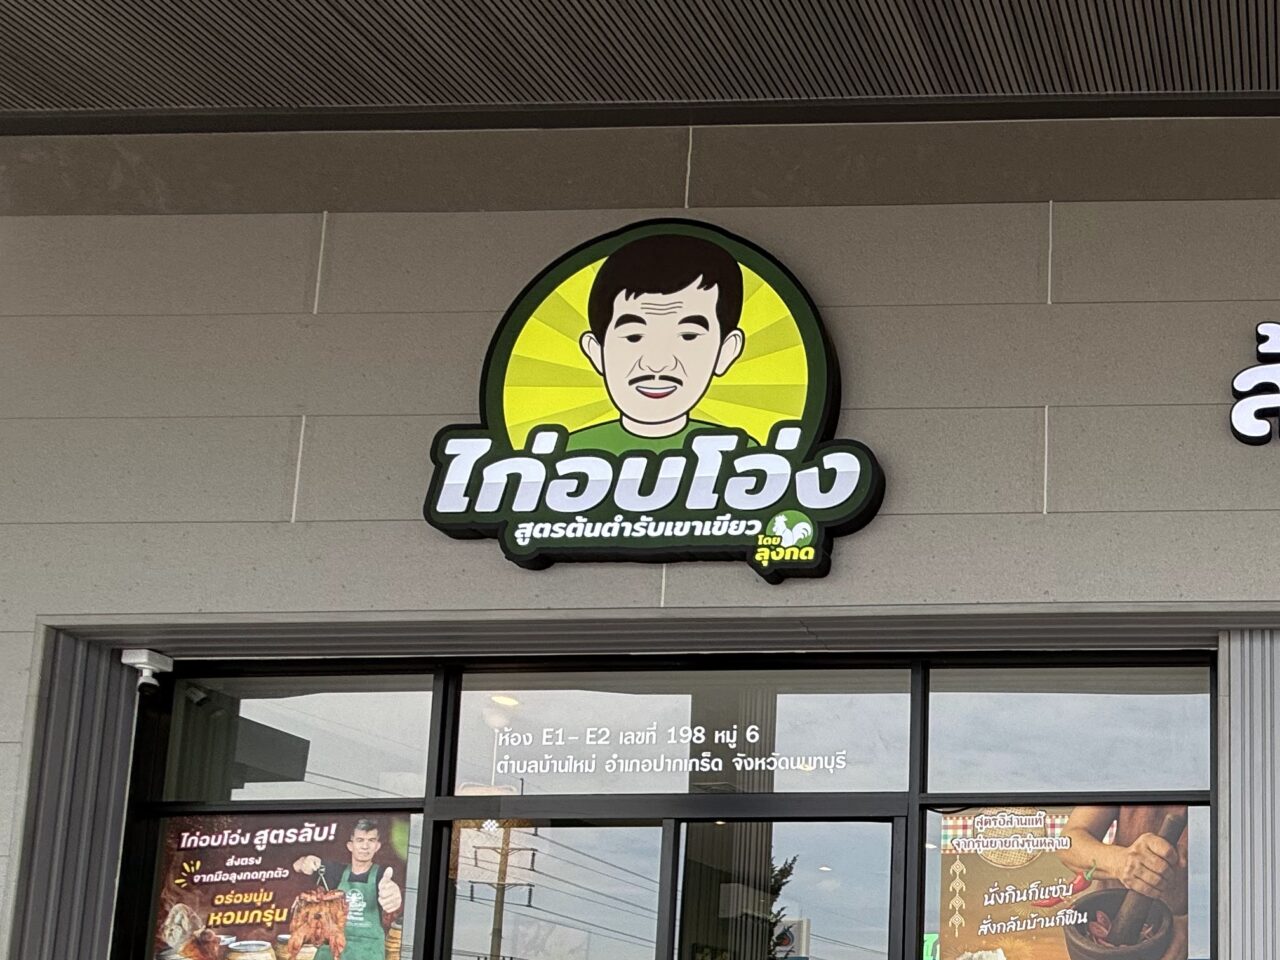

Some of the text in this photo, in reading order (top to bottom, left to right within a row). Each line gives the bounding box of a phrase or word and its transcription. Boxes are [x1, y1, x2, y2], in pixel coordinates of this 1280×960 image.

[435, 427, 862, 514] ไก่อบโอ่ง
[513, 508, 762, 547] สูตรต้นตำรับเขาเขียว
[757, 534, 781, 546] โดย
[754, 543, 815, 567] ลุงกด
[497, 728, 533, 746] ห้อง
[585, 728, 611, 745] E2
[618, 722, 657, 746] เลขที่
[666, 725, 706, 744] 198
[714, 725, 738, 749] หมู่
[745, 725, 760, 744] 6
[496, 749, 848, 775] ตำบลบ้านใหม่ อำเภอปากเกร็ด จังหวัดนนทบุรี
[179, 822, 338, 851] ไก่อบโอ่ง สูตรลับ!
[225, 855, 263, 868] ส่งตรง
[213, 888, 274, 907] อร่อยนุ่ม
[983, 877, 1075, 907] นั่งกินก็แซ่บ
[207, 905, 289, 928] หอมกรุ่น
[977, 908, 1089, 936] สั่งกลับบ้านก็ฟิน
